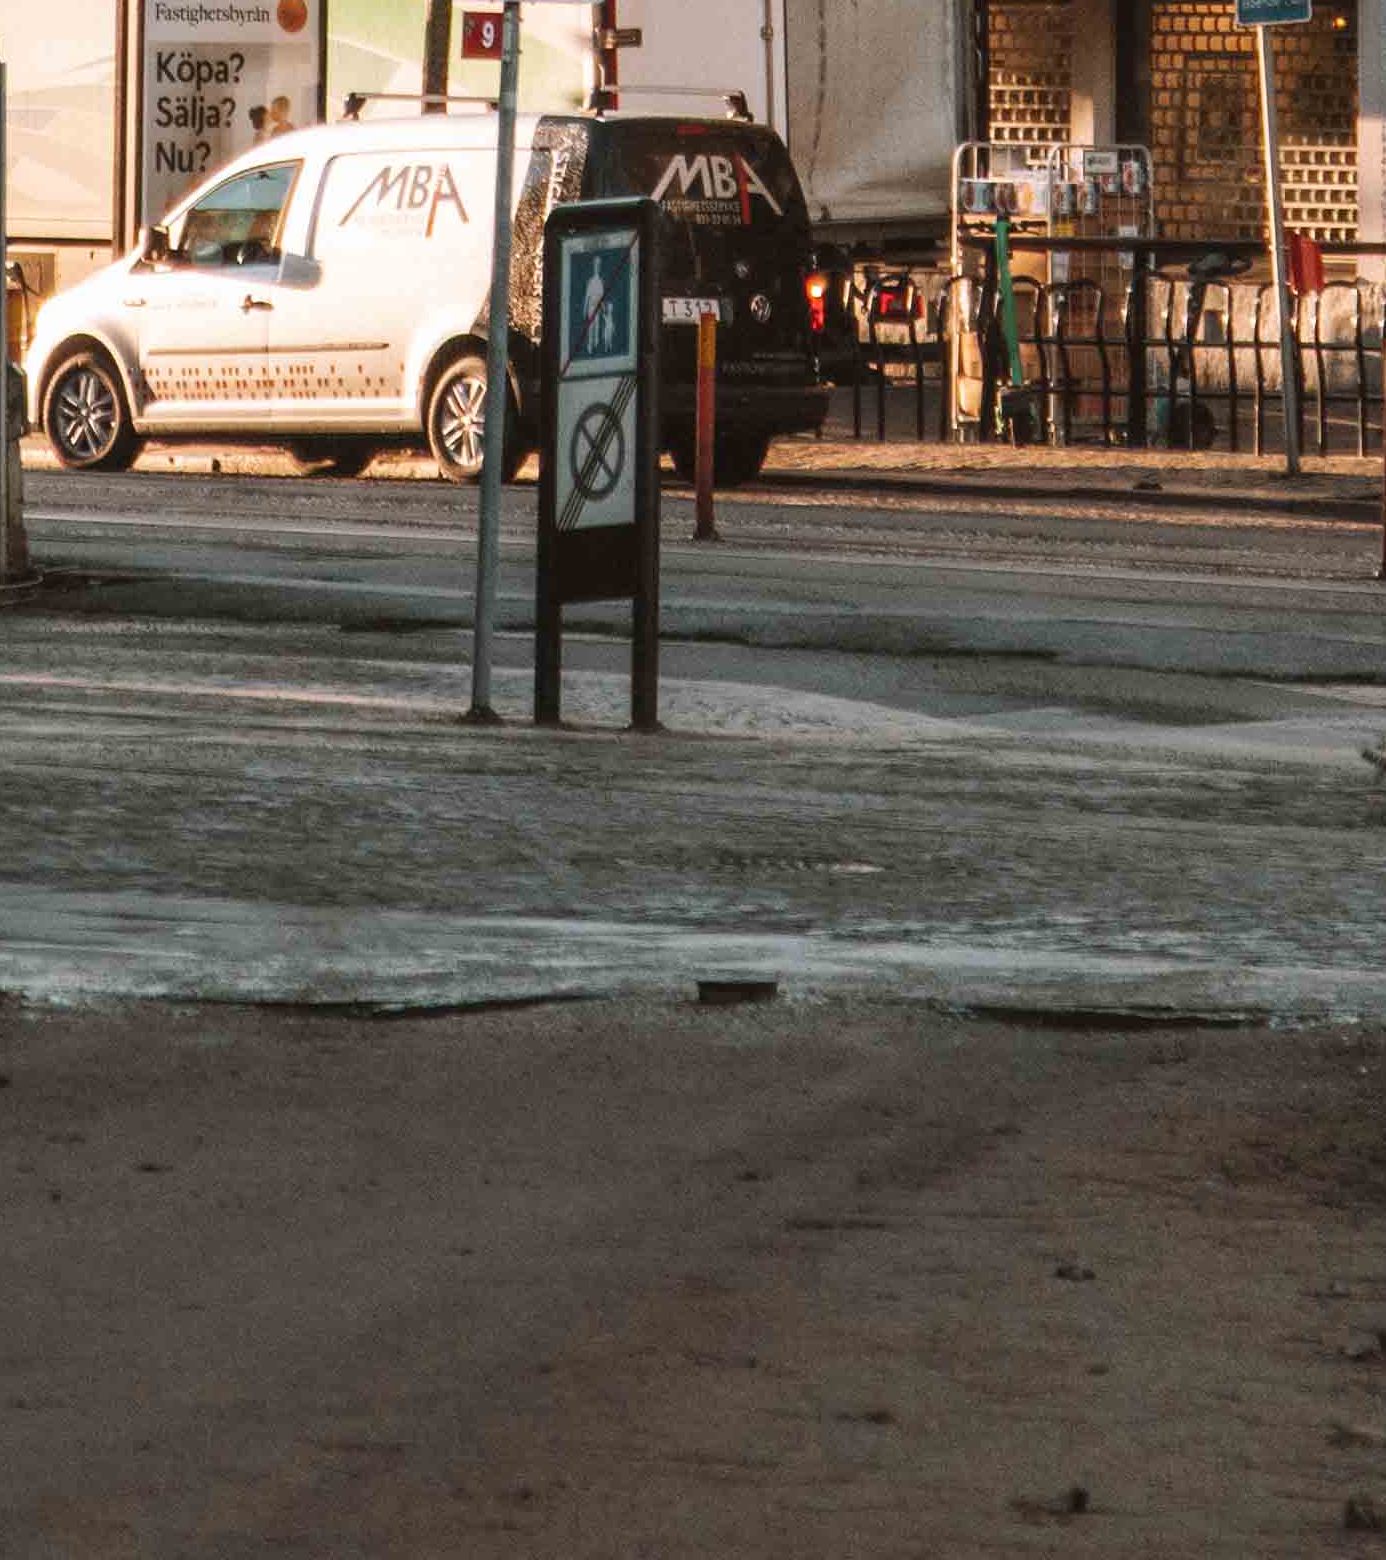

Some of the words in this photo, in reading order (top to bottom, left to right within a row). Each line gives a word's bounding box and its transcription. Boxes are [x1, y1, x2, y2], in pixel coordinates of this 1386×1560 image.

[155, 2, 270, 26] Fastighetsbyrån
[483, 21, 494, 48] 9
[156, 51, 245, 91] Köpa?
[156, 95, 236, 137] Sälja?
[156, 141, 212, 174] Nu?
[337, 162, 470, 239] MBA
[650, 152, 784, 225] MBA
